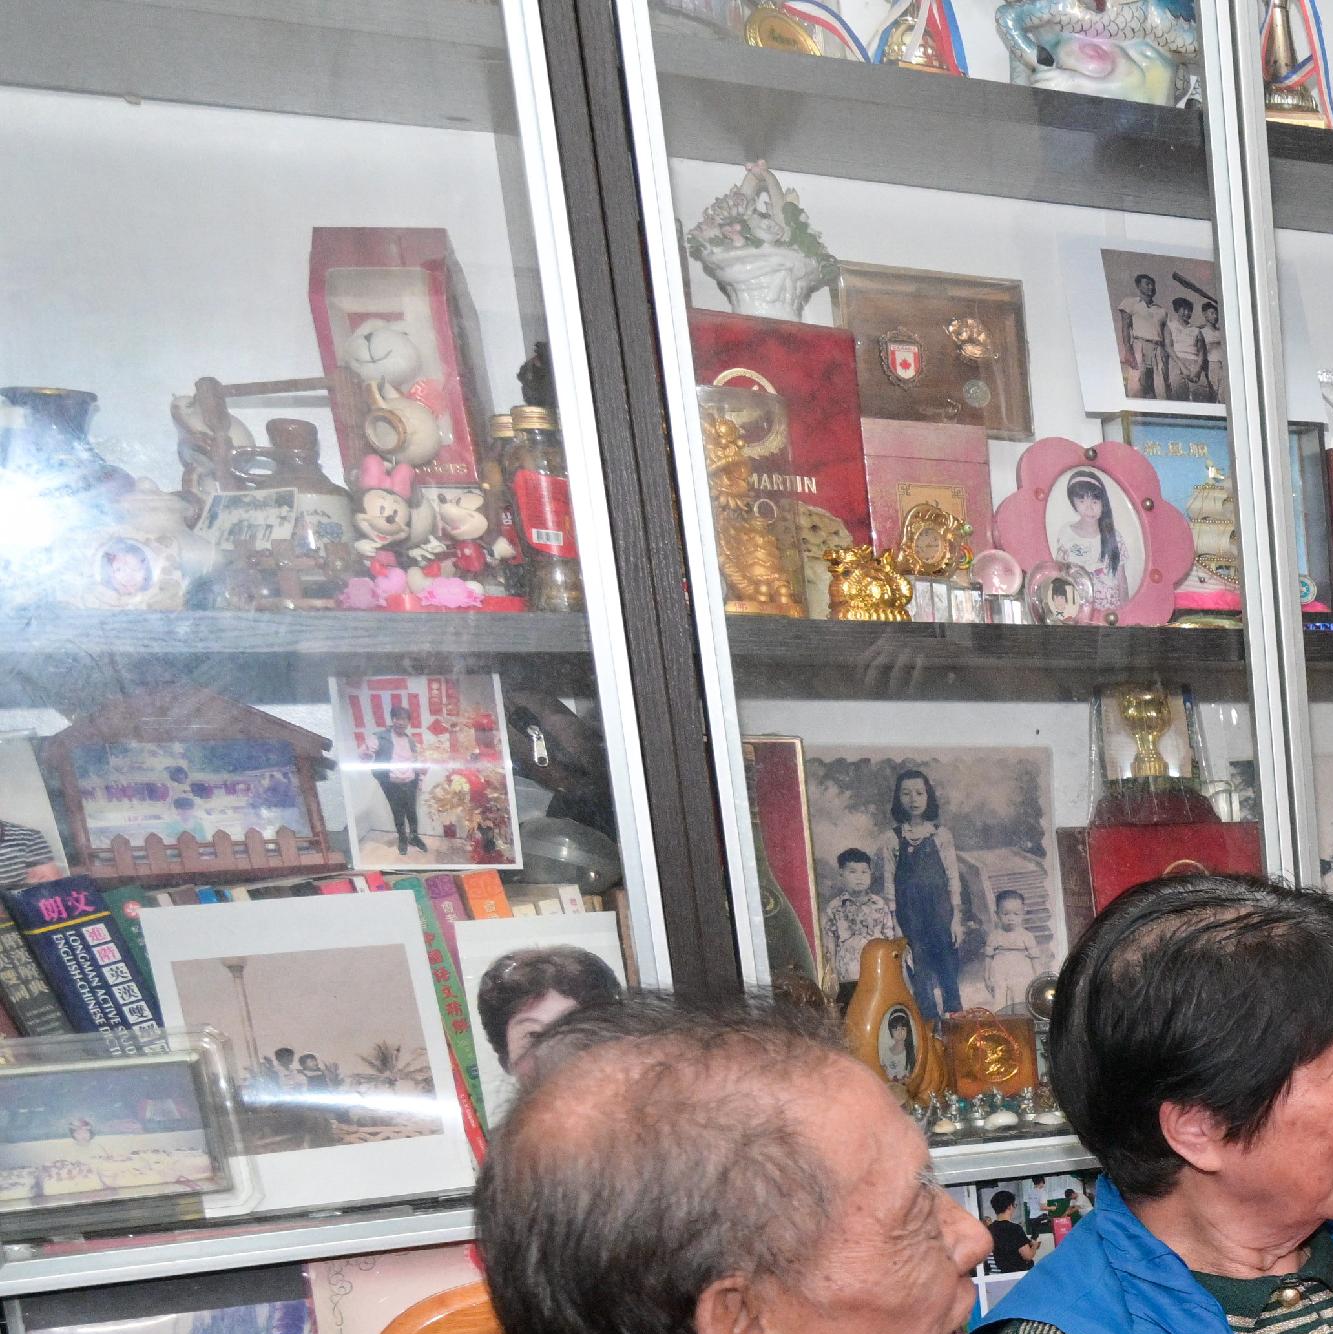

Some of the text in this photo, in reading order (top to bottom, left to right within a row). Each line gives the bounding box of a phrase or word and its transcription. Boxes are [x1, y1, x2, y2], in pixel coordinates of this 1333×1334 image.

[748, 473, 817, 494] MARTIN
[38, 890, 97, 922] 朗文
[53, 934, 106, 1026] ENGLISH-CHINESE
[66, 931, 102, 987] LONGMAN
[95, 988, 122, 1026] ACTIVE
